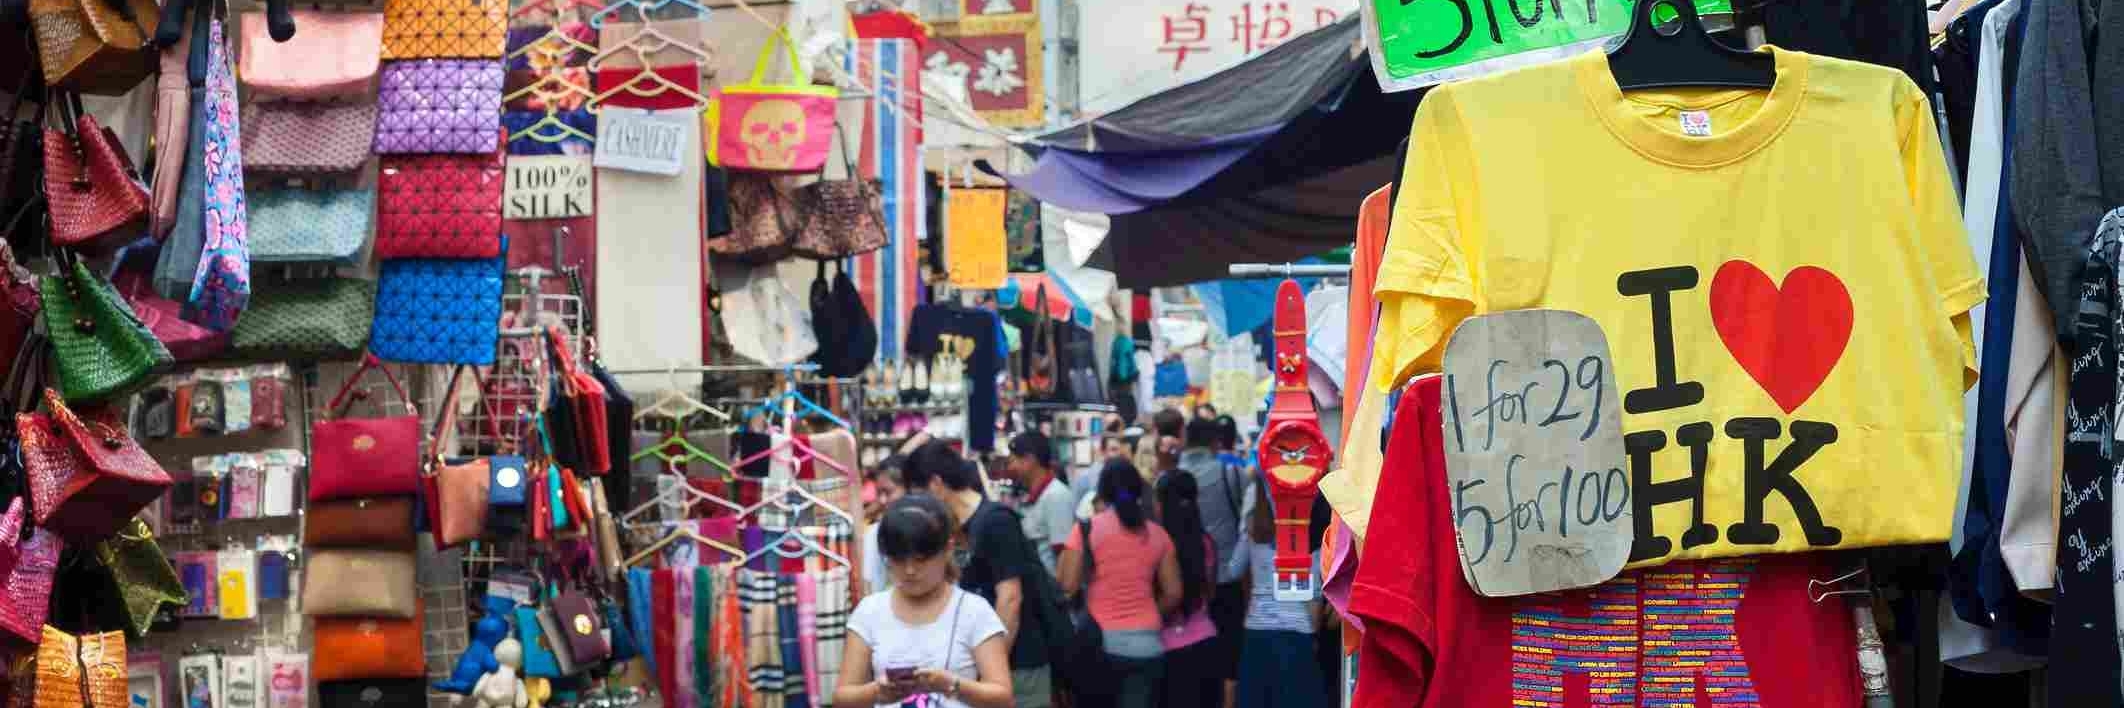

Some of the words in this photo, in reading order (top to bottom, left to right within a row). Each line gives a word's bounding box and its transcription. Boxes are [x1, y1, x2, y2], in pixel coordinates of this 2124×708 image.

[511, 193, 585, 217] SILK
[512, 164, 587, 190] 100%
[1617, 264, 1705, 415] I
[1447, 374, 1464, 452] 1
[1472, 359, 1540, 450] for
[1537, 356, 1602, 441] 29
[1456, 479, 1494, 565] 5
[1493, 454, 1560, 562] for
[1559, 465, 1631, 538] 100
[1624, 417, 1842, 563] HK
